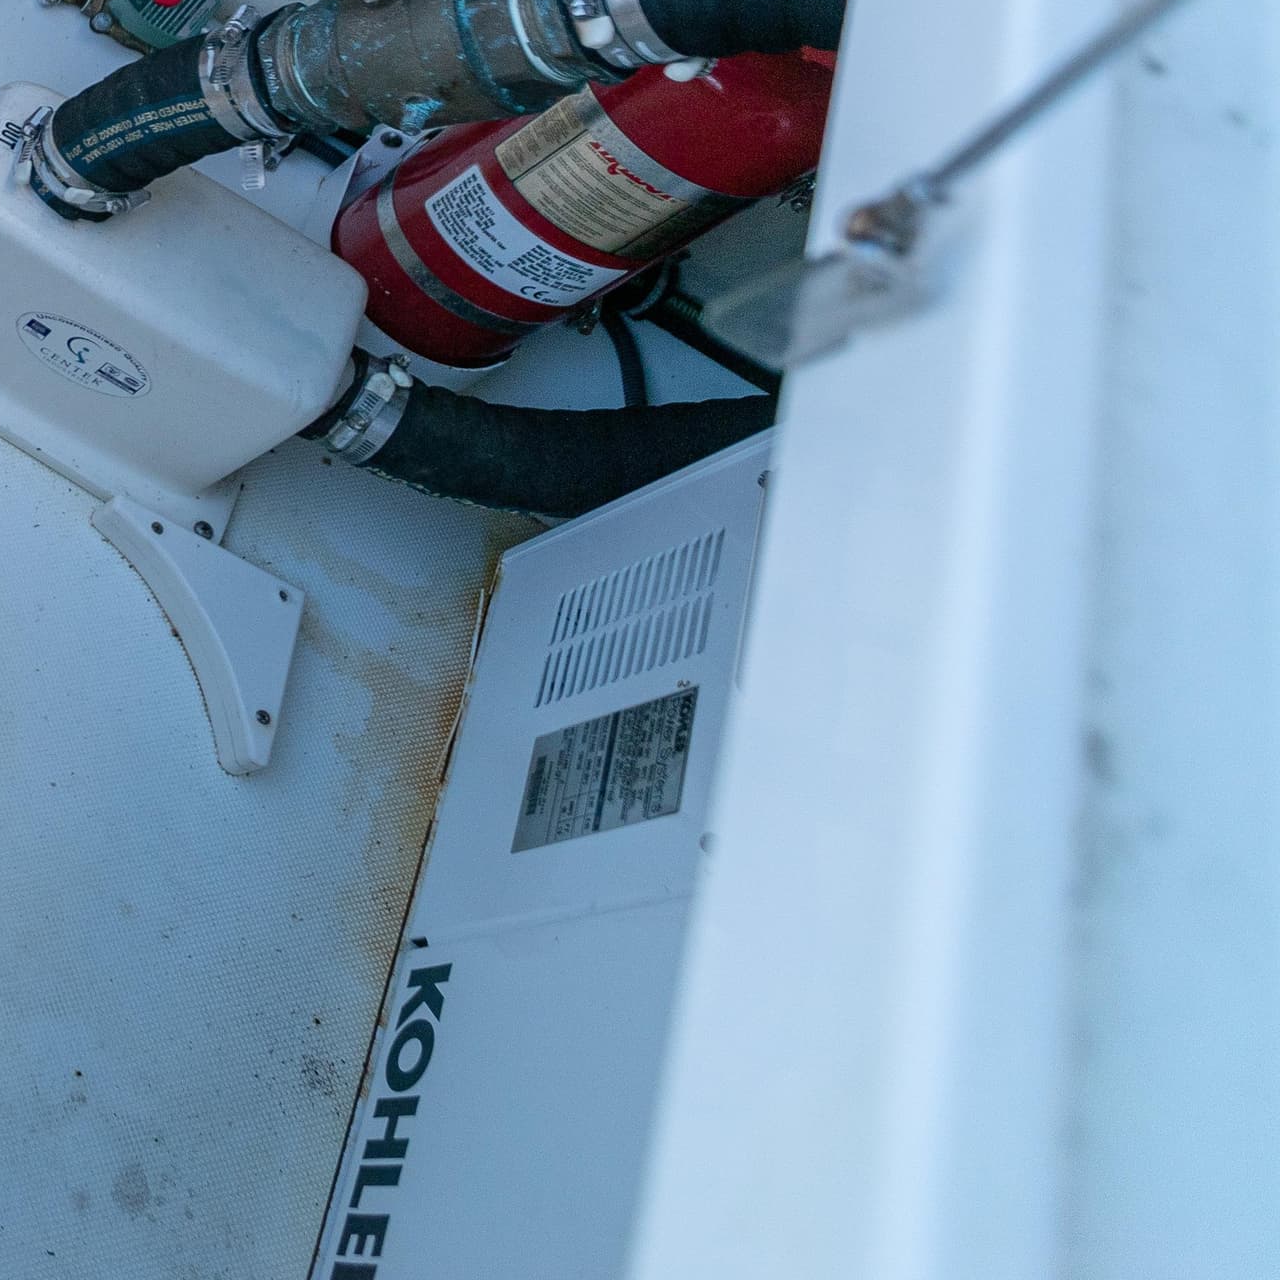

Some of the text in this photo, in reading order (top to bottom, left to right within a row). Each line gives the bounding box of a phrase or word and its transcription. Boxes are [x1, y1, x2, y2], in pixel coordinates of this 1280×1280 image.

[132, 109, 159, 126] CERT
[173, 110, 208, 127] WATER
[148, 119, 174, 134] HOSE
[39, 345, 104, 388] CENTEK
